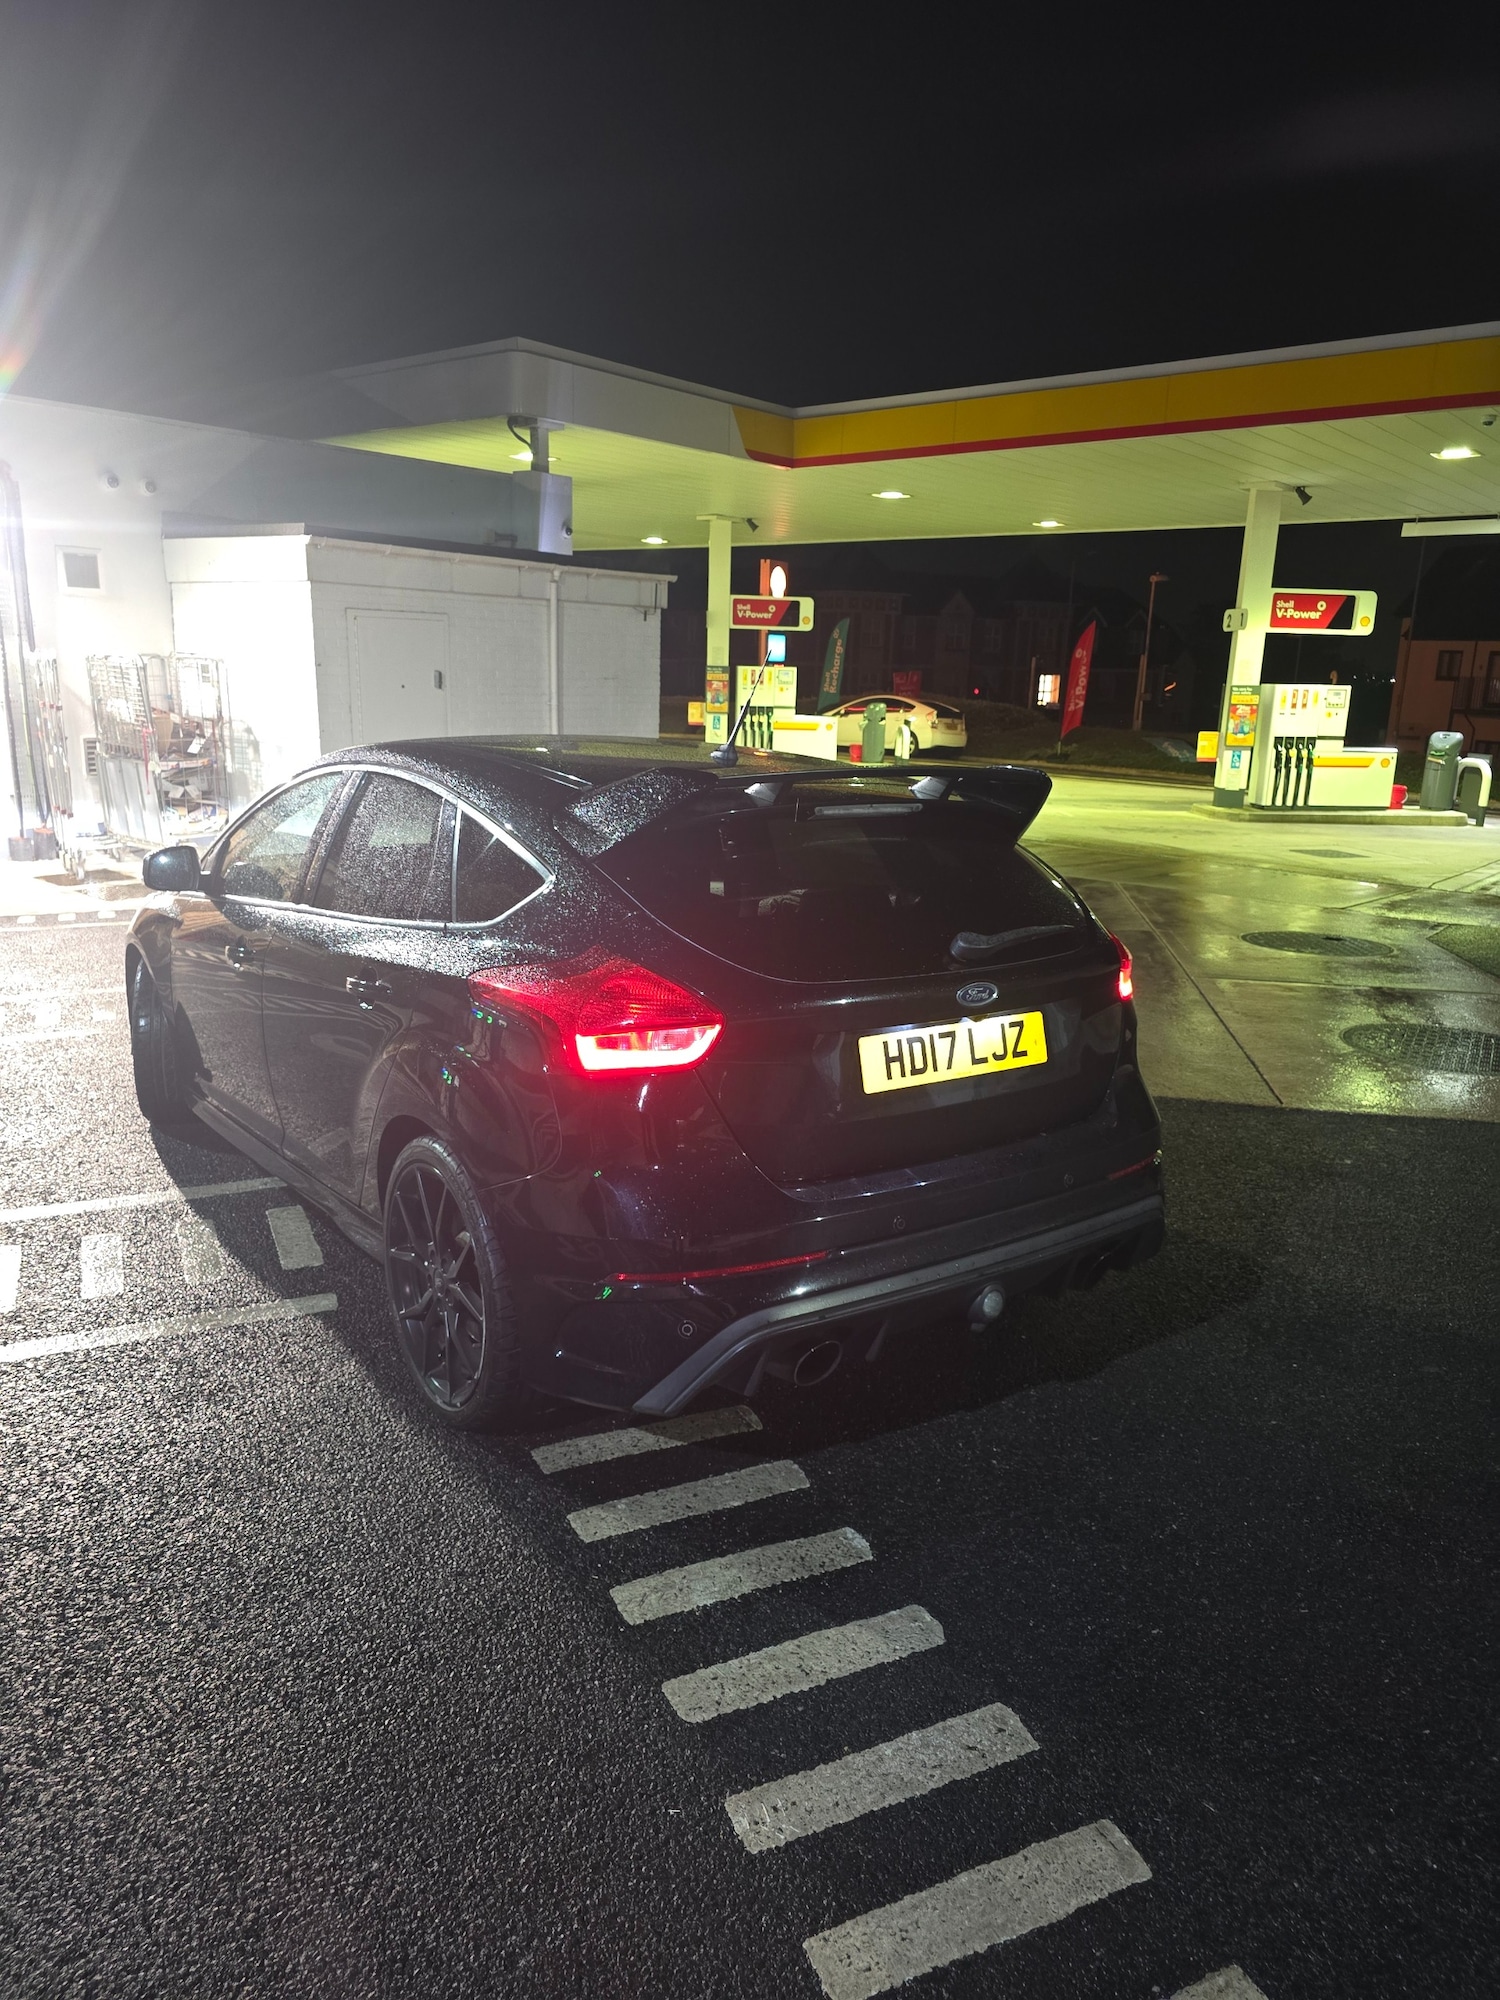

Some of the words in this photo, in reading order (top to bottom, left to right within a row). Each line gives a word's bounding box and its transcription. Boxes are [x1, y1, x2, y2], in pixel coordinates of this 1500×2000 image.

[1276, 600, 1295, 608] Shell
[737, 610, 773, 619] V-Power
[1226, 613, 1232, 628] 2
[1276, 608, 1322, 619] V-Power
[829, 639, 843, 693] Recharge
[966, 987, 990, 1001] Ford
[882, 1030, 956, 1080] HD17
[968, 1020, 1028, 1066] LJZ
